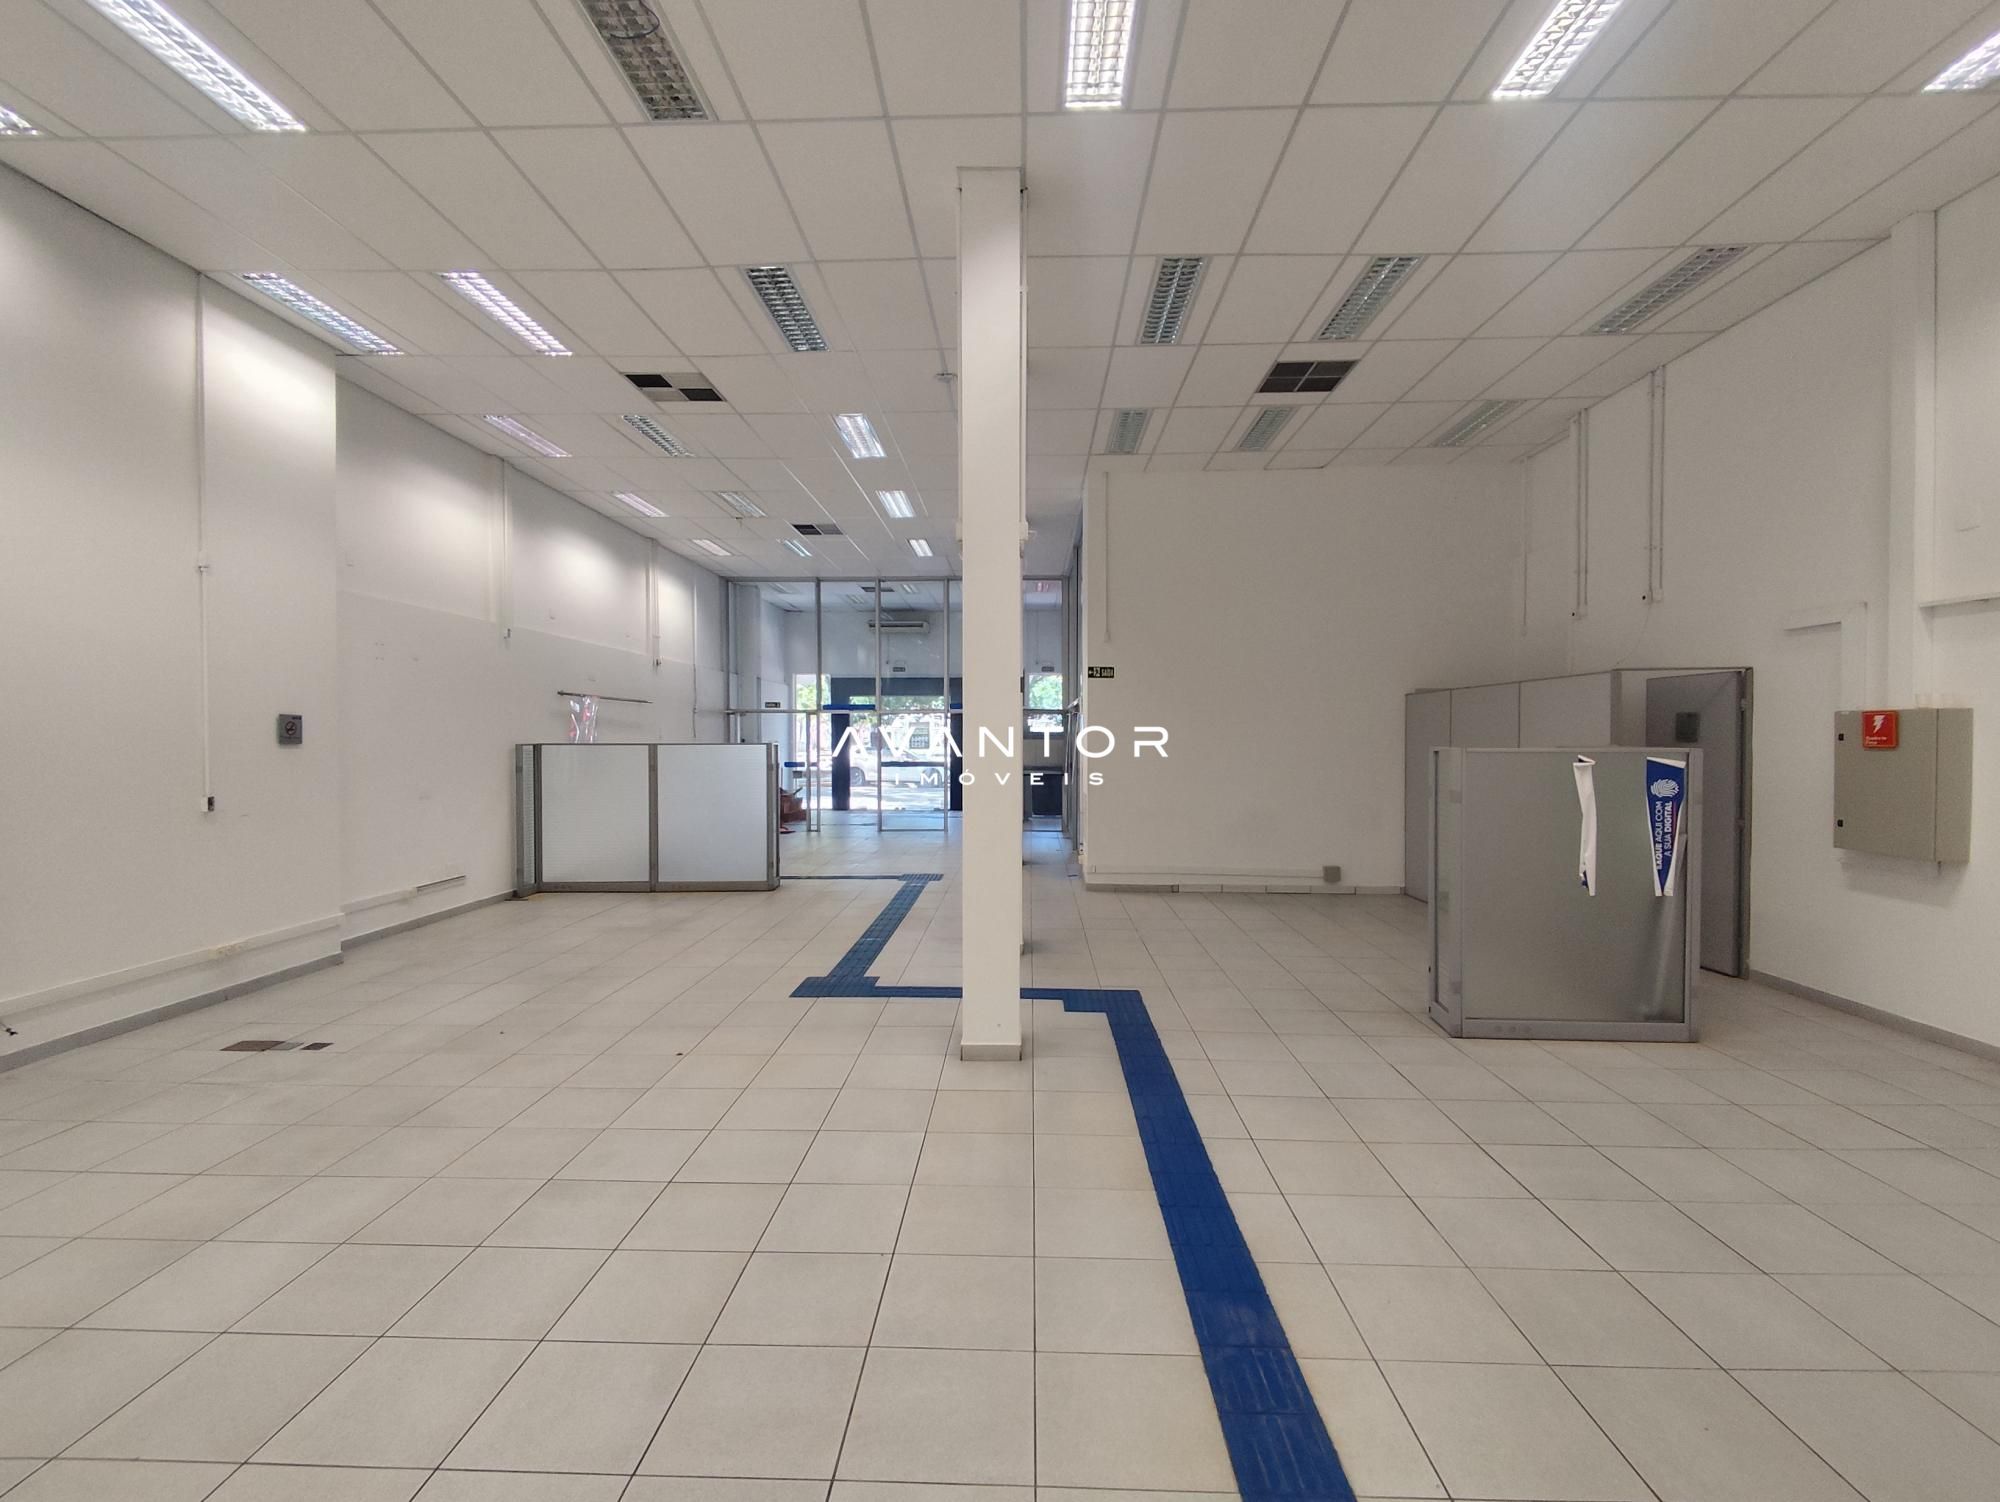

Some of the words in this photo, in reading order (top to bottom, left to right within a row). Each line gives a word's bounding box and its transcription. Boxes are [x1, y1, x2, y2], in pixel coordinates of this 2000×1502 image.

[1655, 801, 1663, 821] COM
[1664, 800, 1673, 832] DIGITAL
[1655, 822, 1663, 842] AQUI
[1664, 833, 1672, 850] SUA
